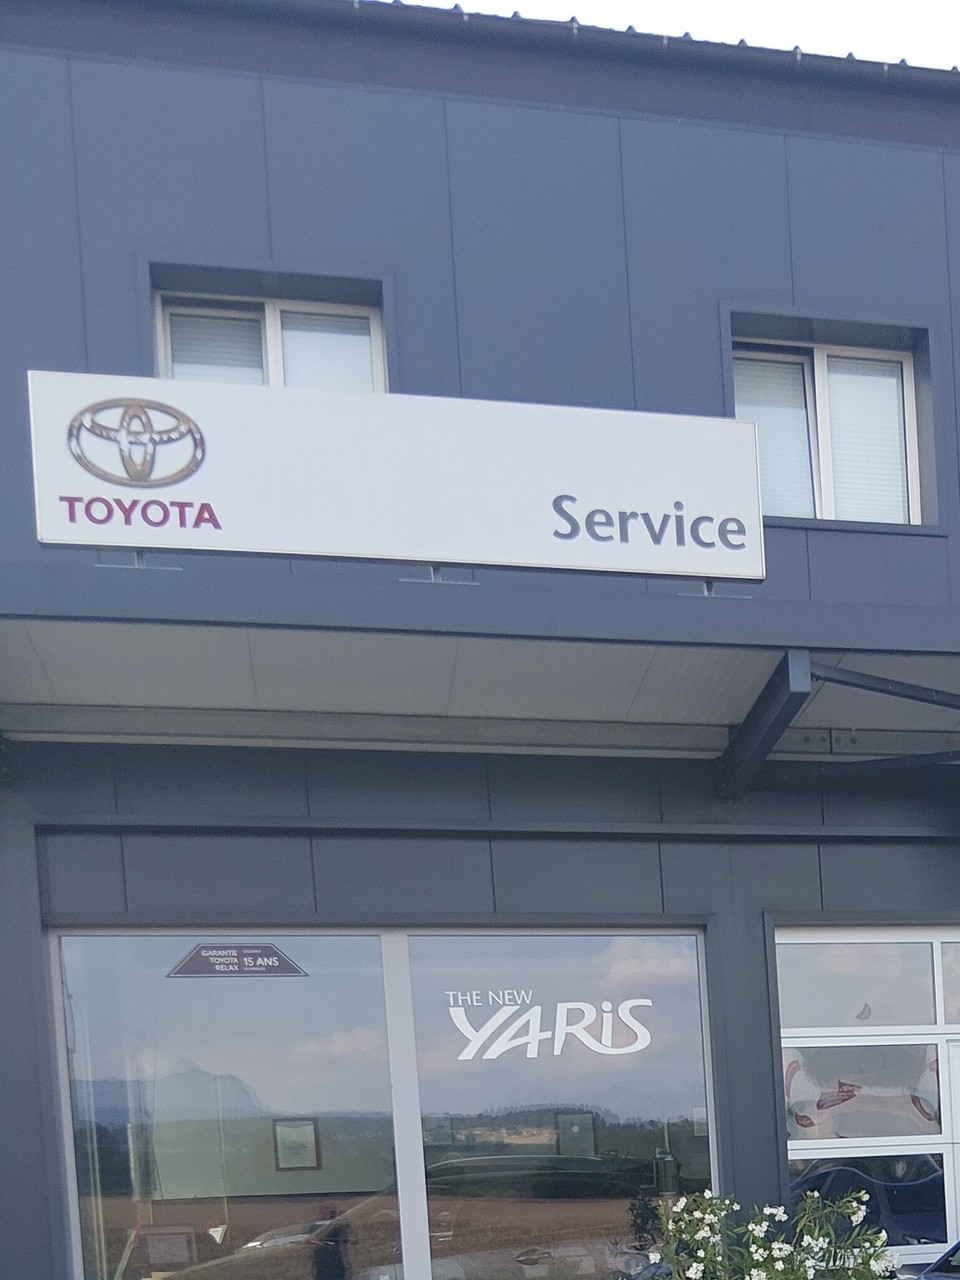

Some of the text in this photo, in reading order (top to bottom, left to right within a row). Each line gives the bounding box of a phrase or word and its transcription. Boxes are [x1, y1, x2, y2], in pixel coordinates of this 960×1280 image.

[58, 495, 223, 531] TOYOTA
[551, 494, 748, 551] Service
[201, 949, 238, 957] GARANTIE
[215, 964, 240, 972] RELAX
[243, 956, 280, 967] 15 ANS
[444, 988, 533, 1007] THE NEW
